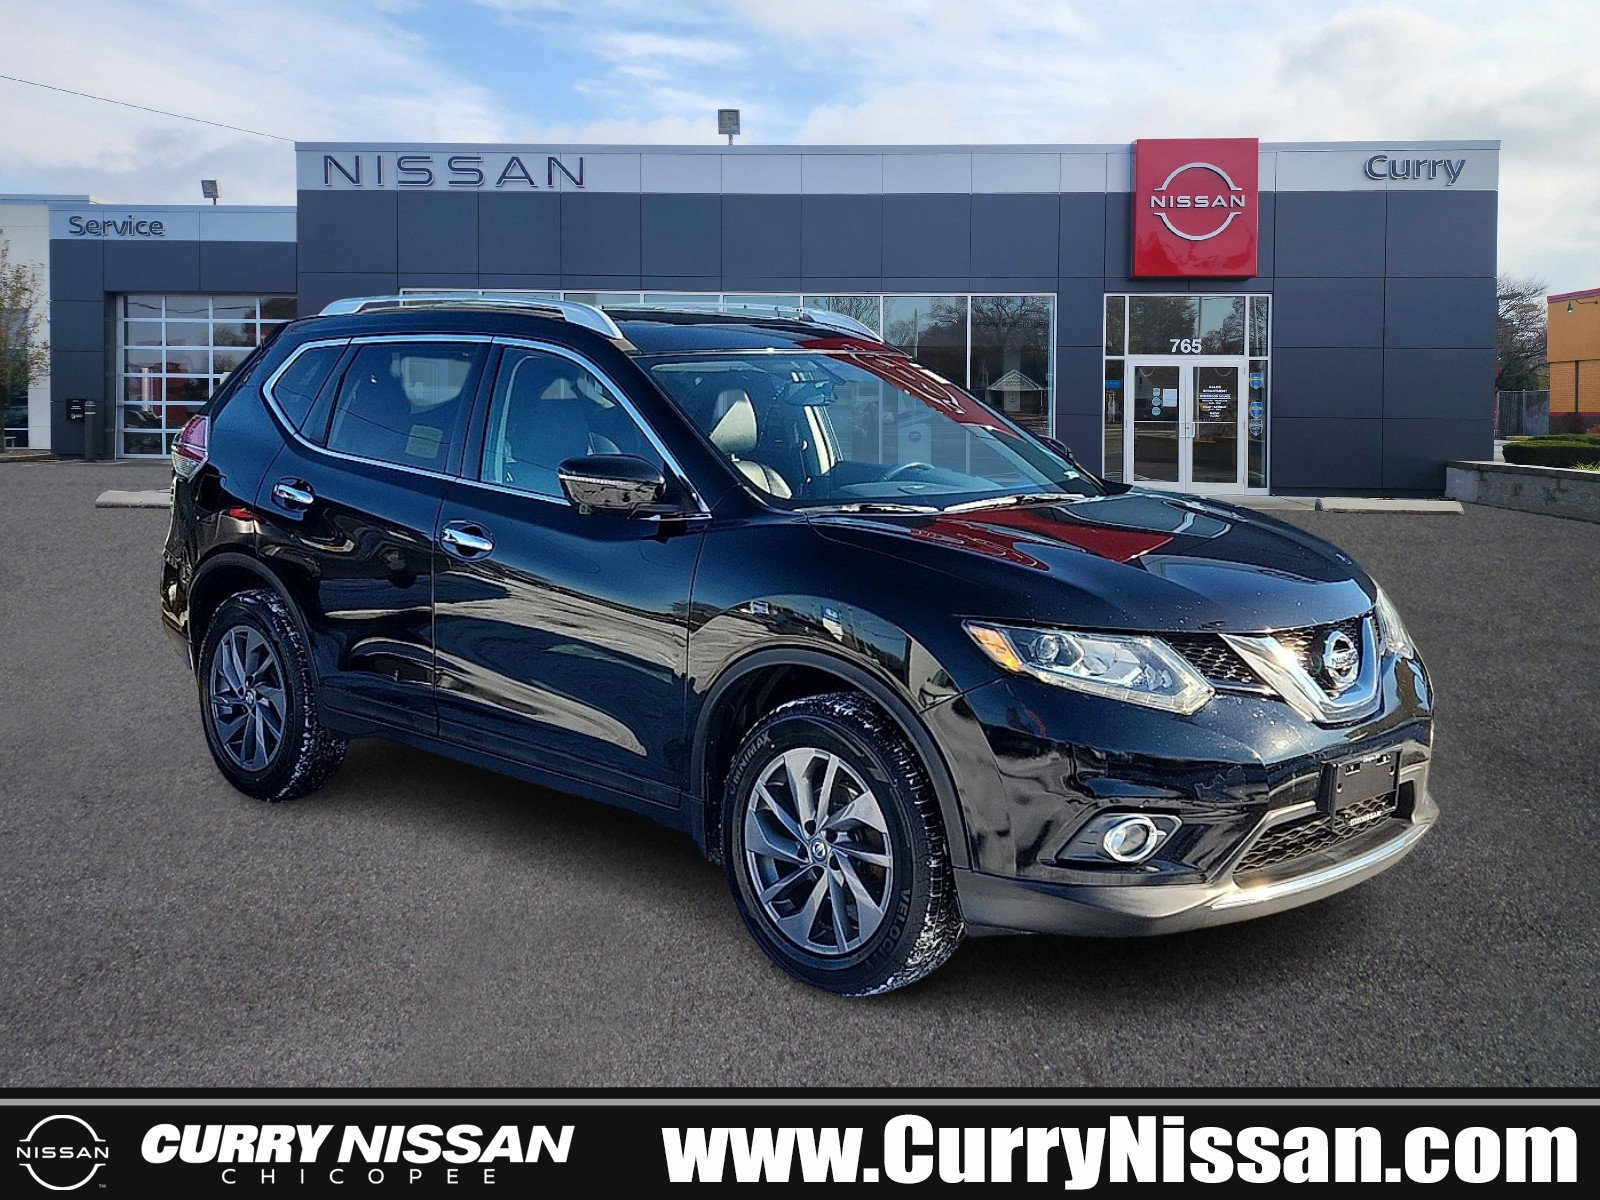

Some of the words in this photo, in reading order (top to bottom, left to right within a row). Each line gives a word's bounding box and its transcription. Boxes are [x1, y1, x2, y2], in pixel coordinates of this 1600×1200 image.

[323, 155, 585, 188] NISSAN
[1364, 154, 1466, 187] Curry
[1149, 194, 1246, 209] NISSAN
[68, 214, 165, 237] Service
[1169, 338, 1202, 354] 765
